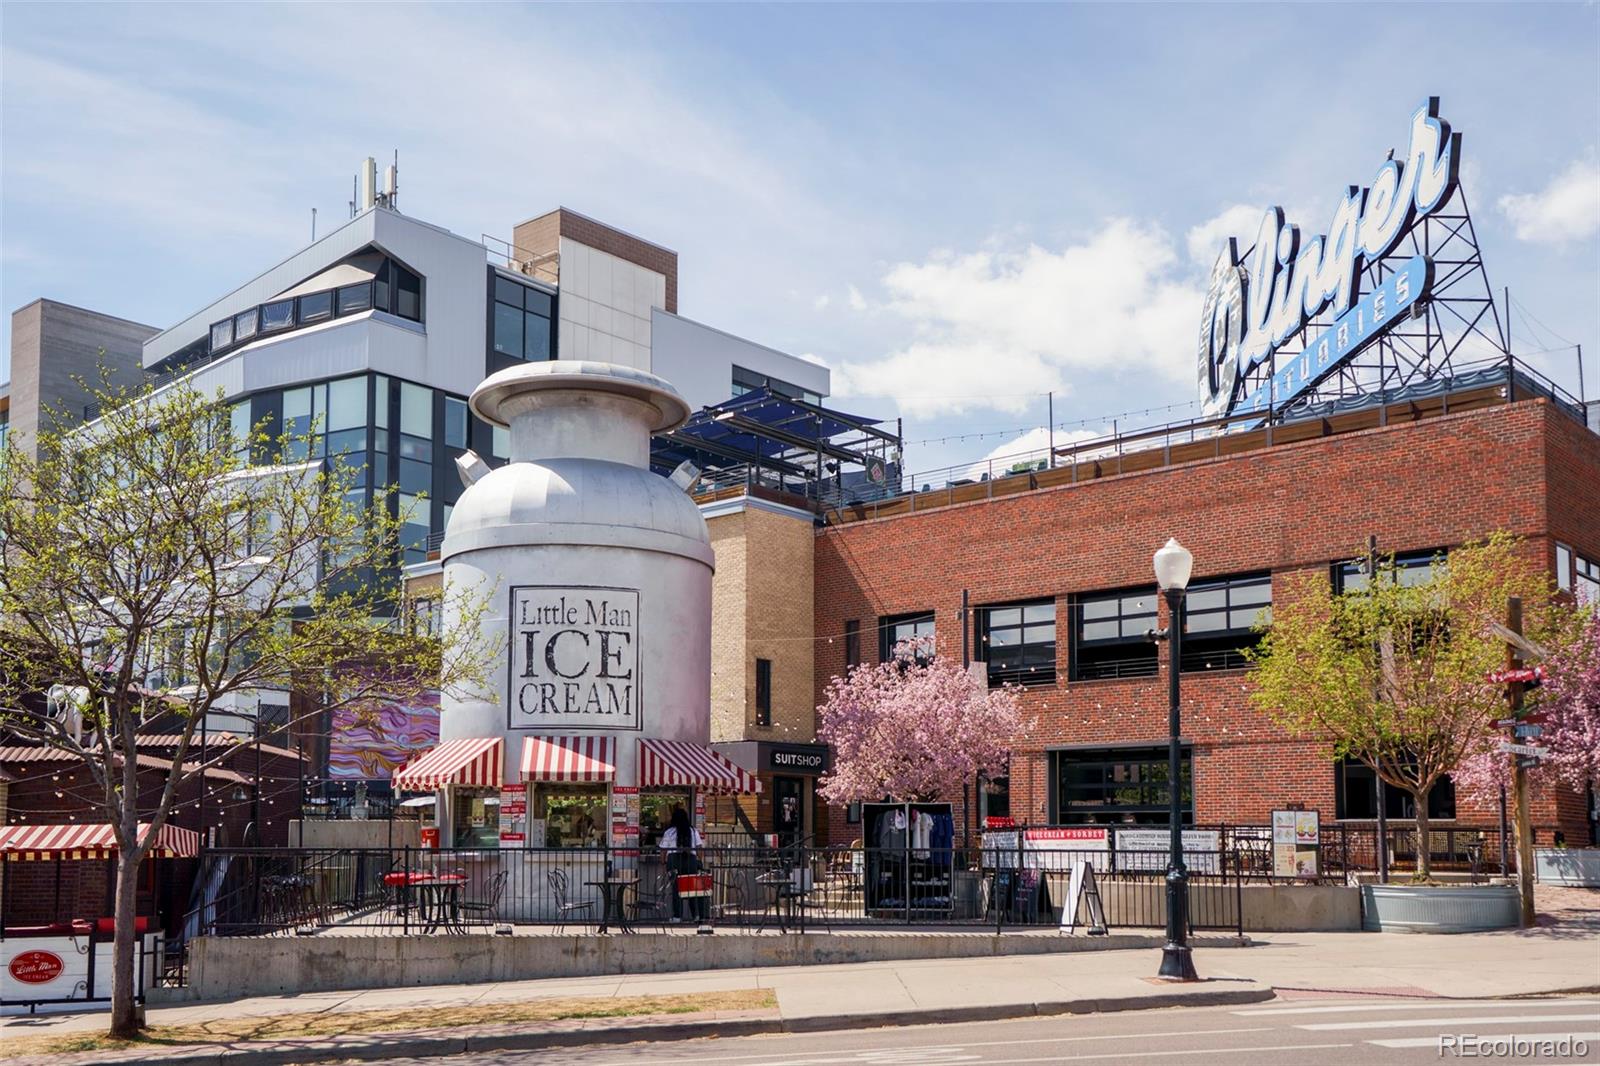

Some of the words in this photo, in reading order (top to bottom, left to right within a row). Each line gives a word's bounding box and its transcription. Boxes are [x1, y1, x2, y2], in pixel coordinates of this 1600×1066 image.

[520, 596, 578, 625] Little
[584, 599, 632, 627] Man
[519, 629, 632, 680] ICE
[519, 682, 633, 716] CREAM
[775, 753, 822, 767] SUITSHOP
[1072, 830, 1103, 838] SORBET
